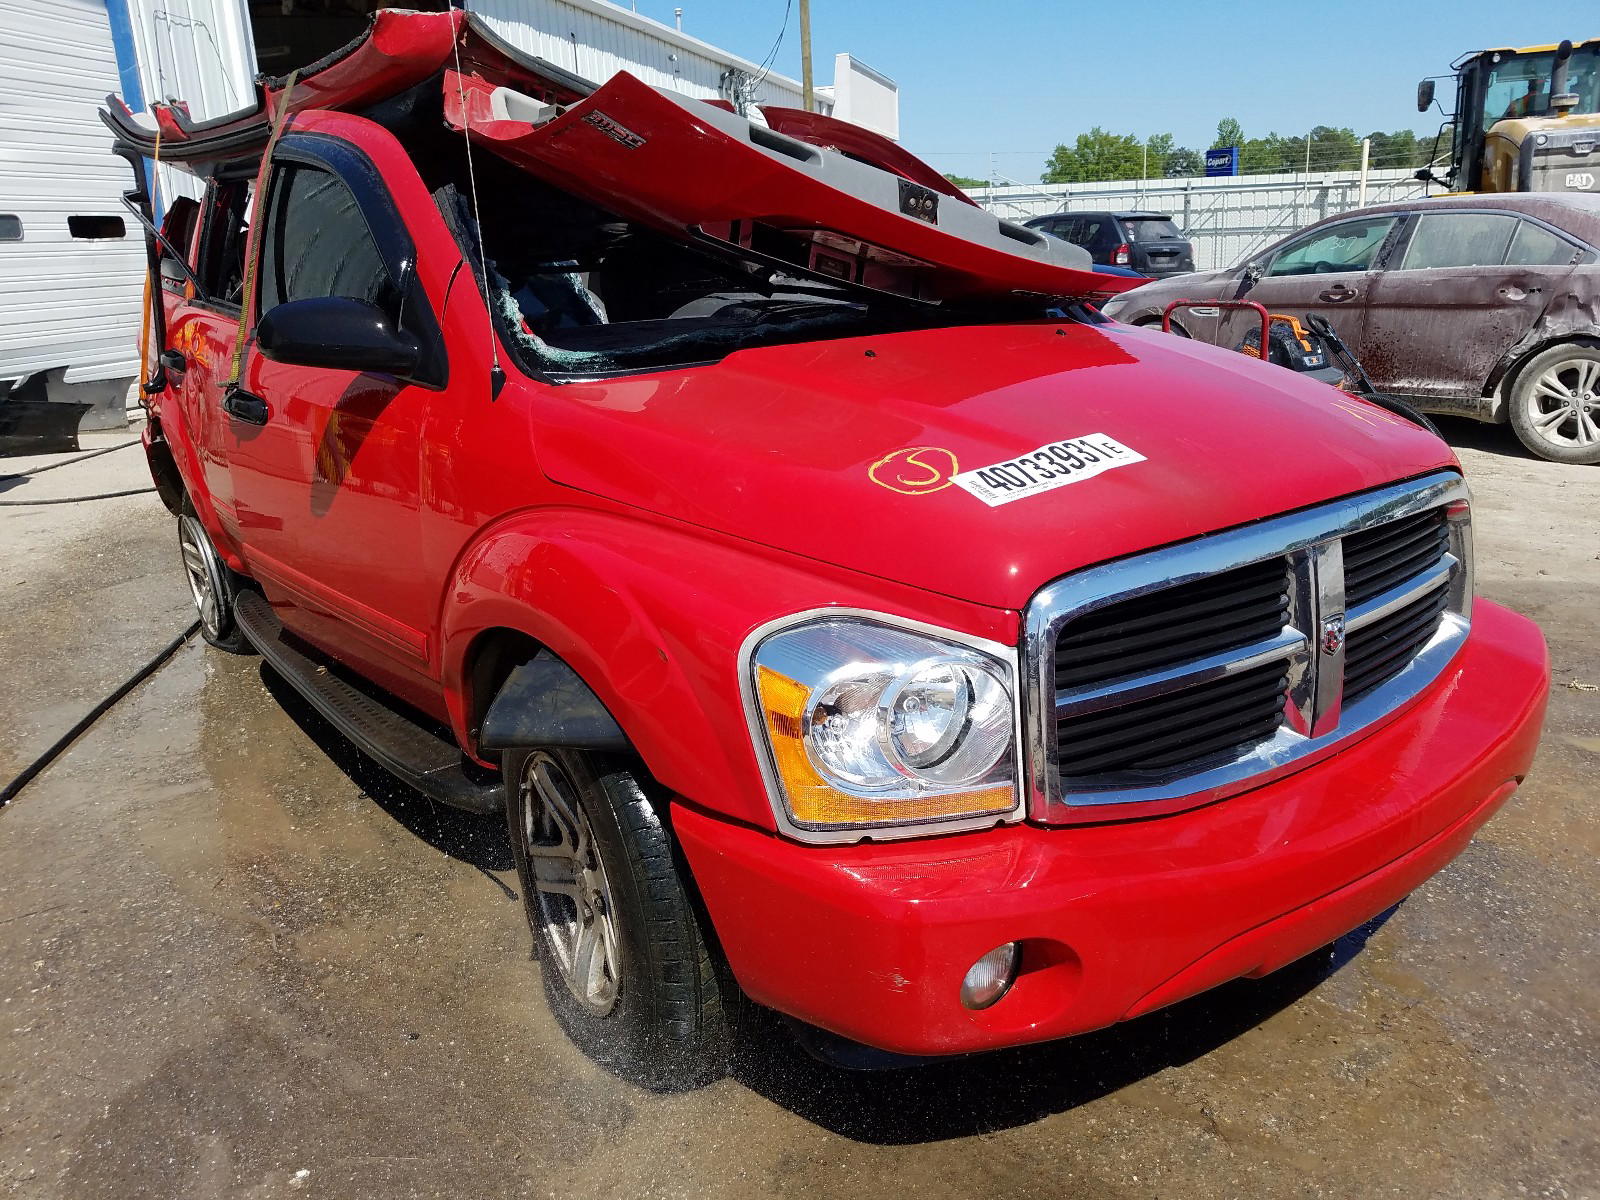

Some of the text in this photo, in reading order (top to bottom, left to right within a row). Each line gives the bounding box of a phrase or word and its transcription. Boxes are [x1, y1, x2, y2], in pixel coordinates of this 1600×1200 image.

[1207, 156, 1229, 167] Copart
[1566, 173, 1592, 189] CAT
[976, 439, 1114, 491] 40733931
[1101, 442, 1124, 454] E
